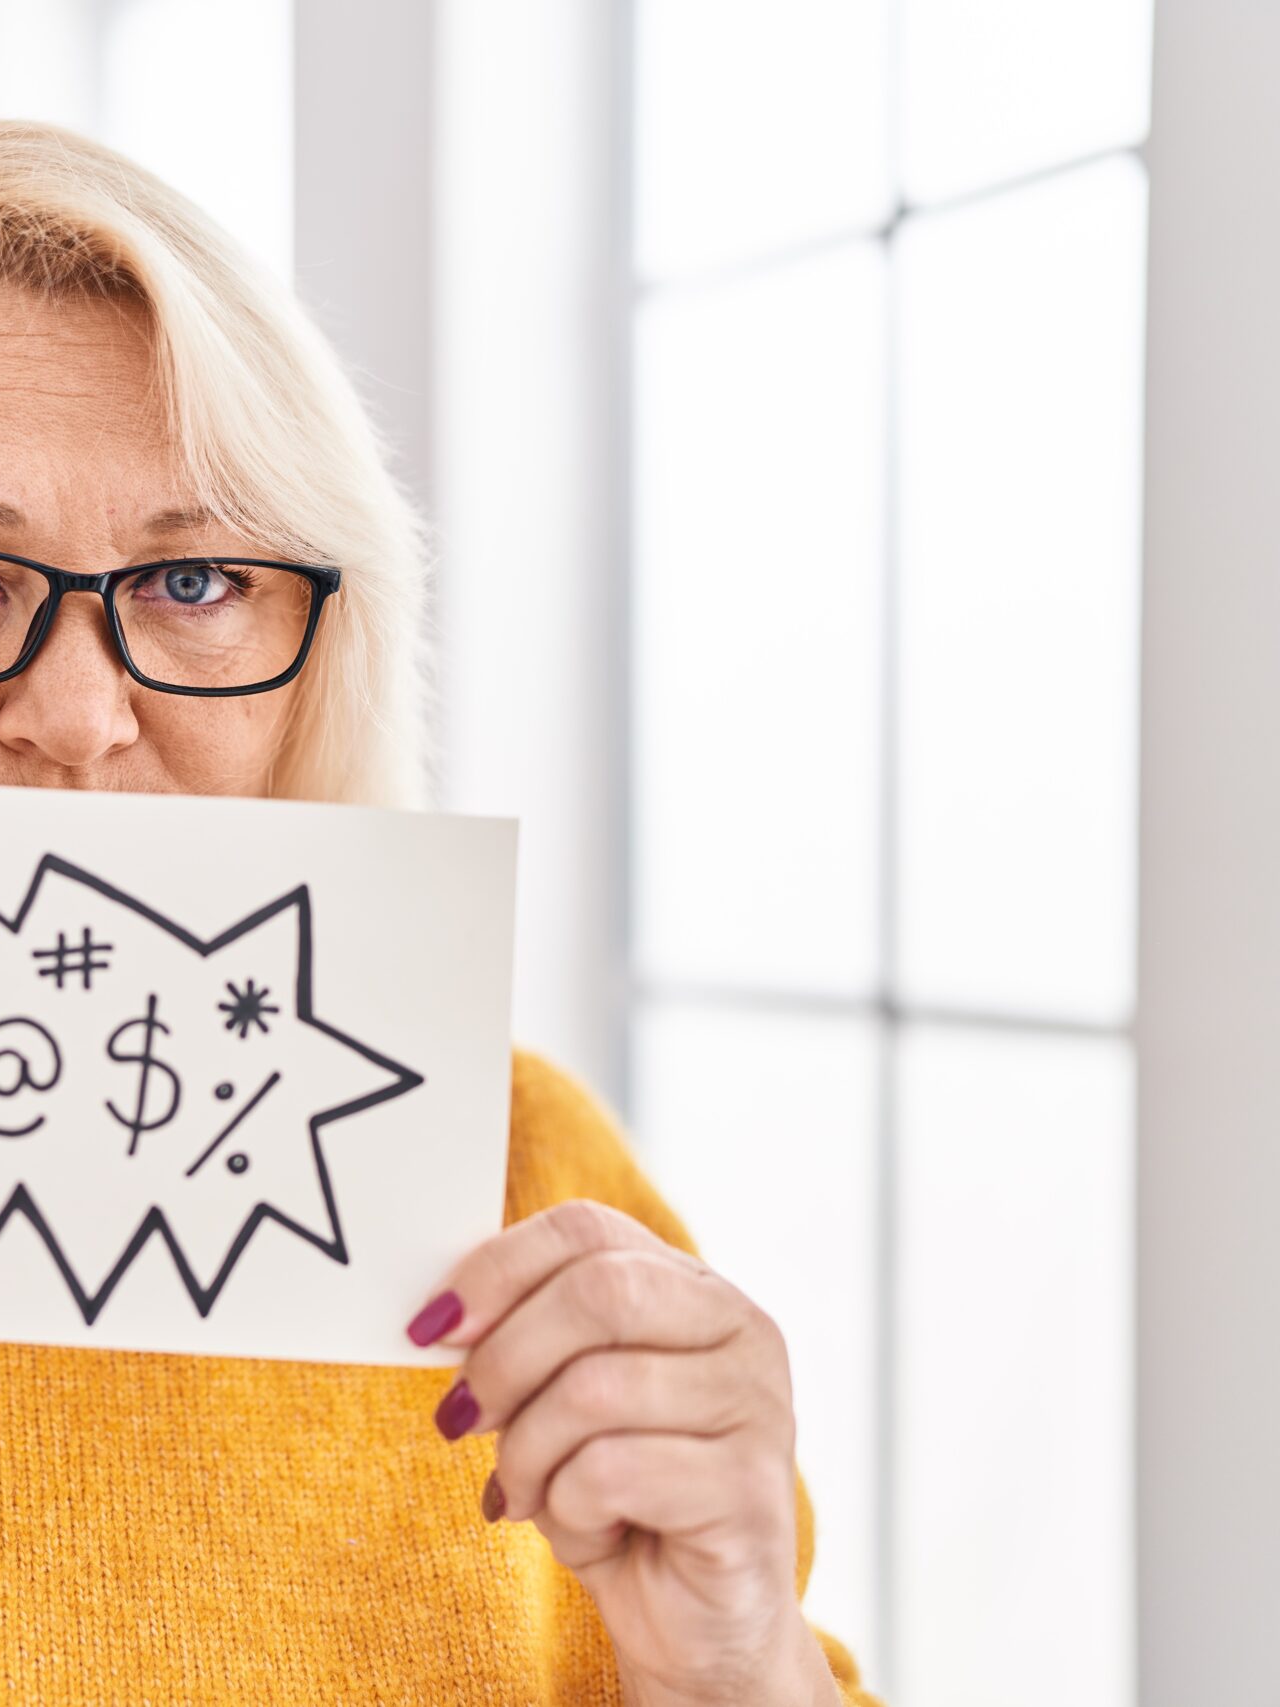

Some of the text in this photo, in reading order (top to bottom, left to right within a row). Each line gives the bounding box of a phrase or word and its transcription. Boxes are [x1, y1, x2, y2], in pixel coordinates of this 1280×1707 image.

[32, 927, 115, 990] #
[105, 993, 182, 1157] $
[185, 1071, 282, 1177] %
